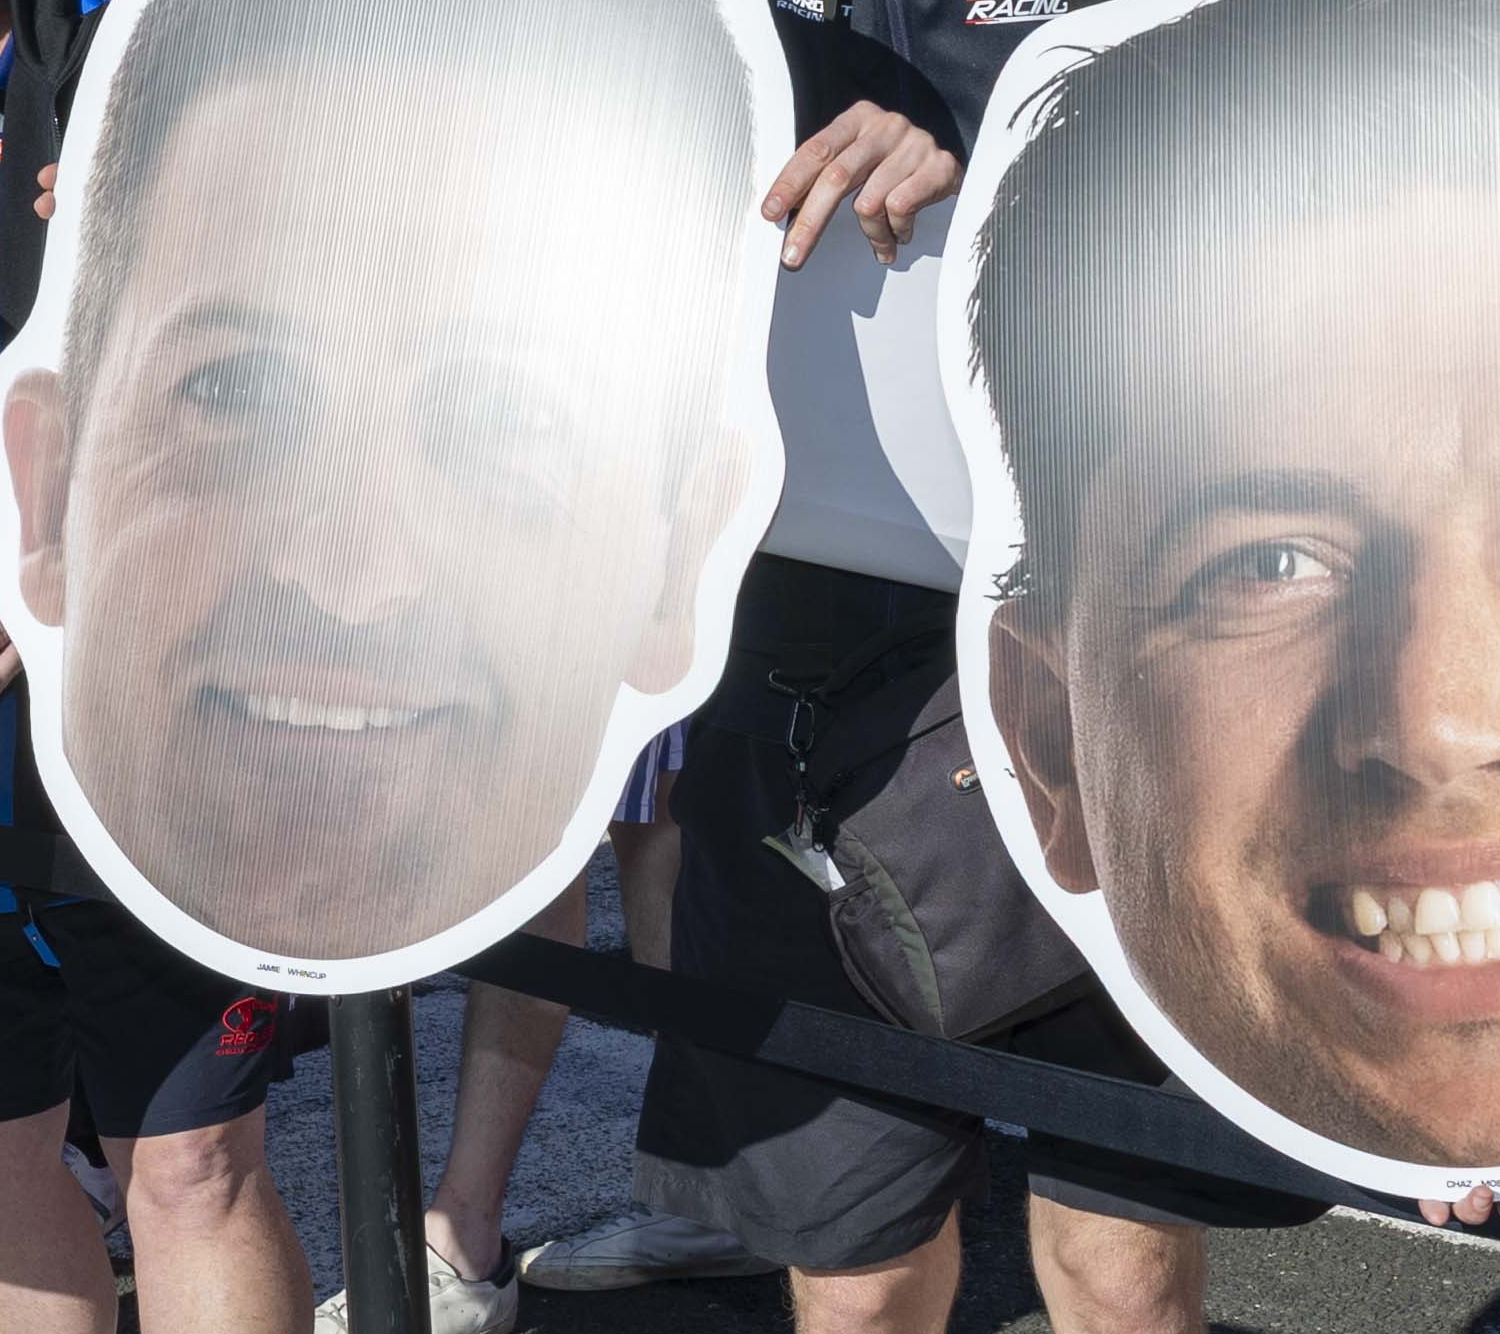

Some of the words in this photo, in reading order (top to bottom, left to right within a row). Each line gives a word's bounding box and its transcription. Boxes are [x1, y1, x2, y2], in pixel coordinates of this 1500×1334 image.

[777, 0, 824, 23] RACIN
[256, 963, 280, 973] JAMIE
[287, 967, 327, 980] WHINCUP
